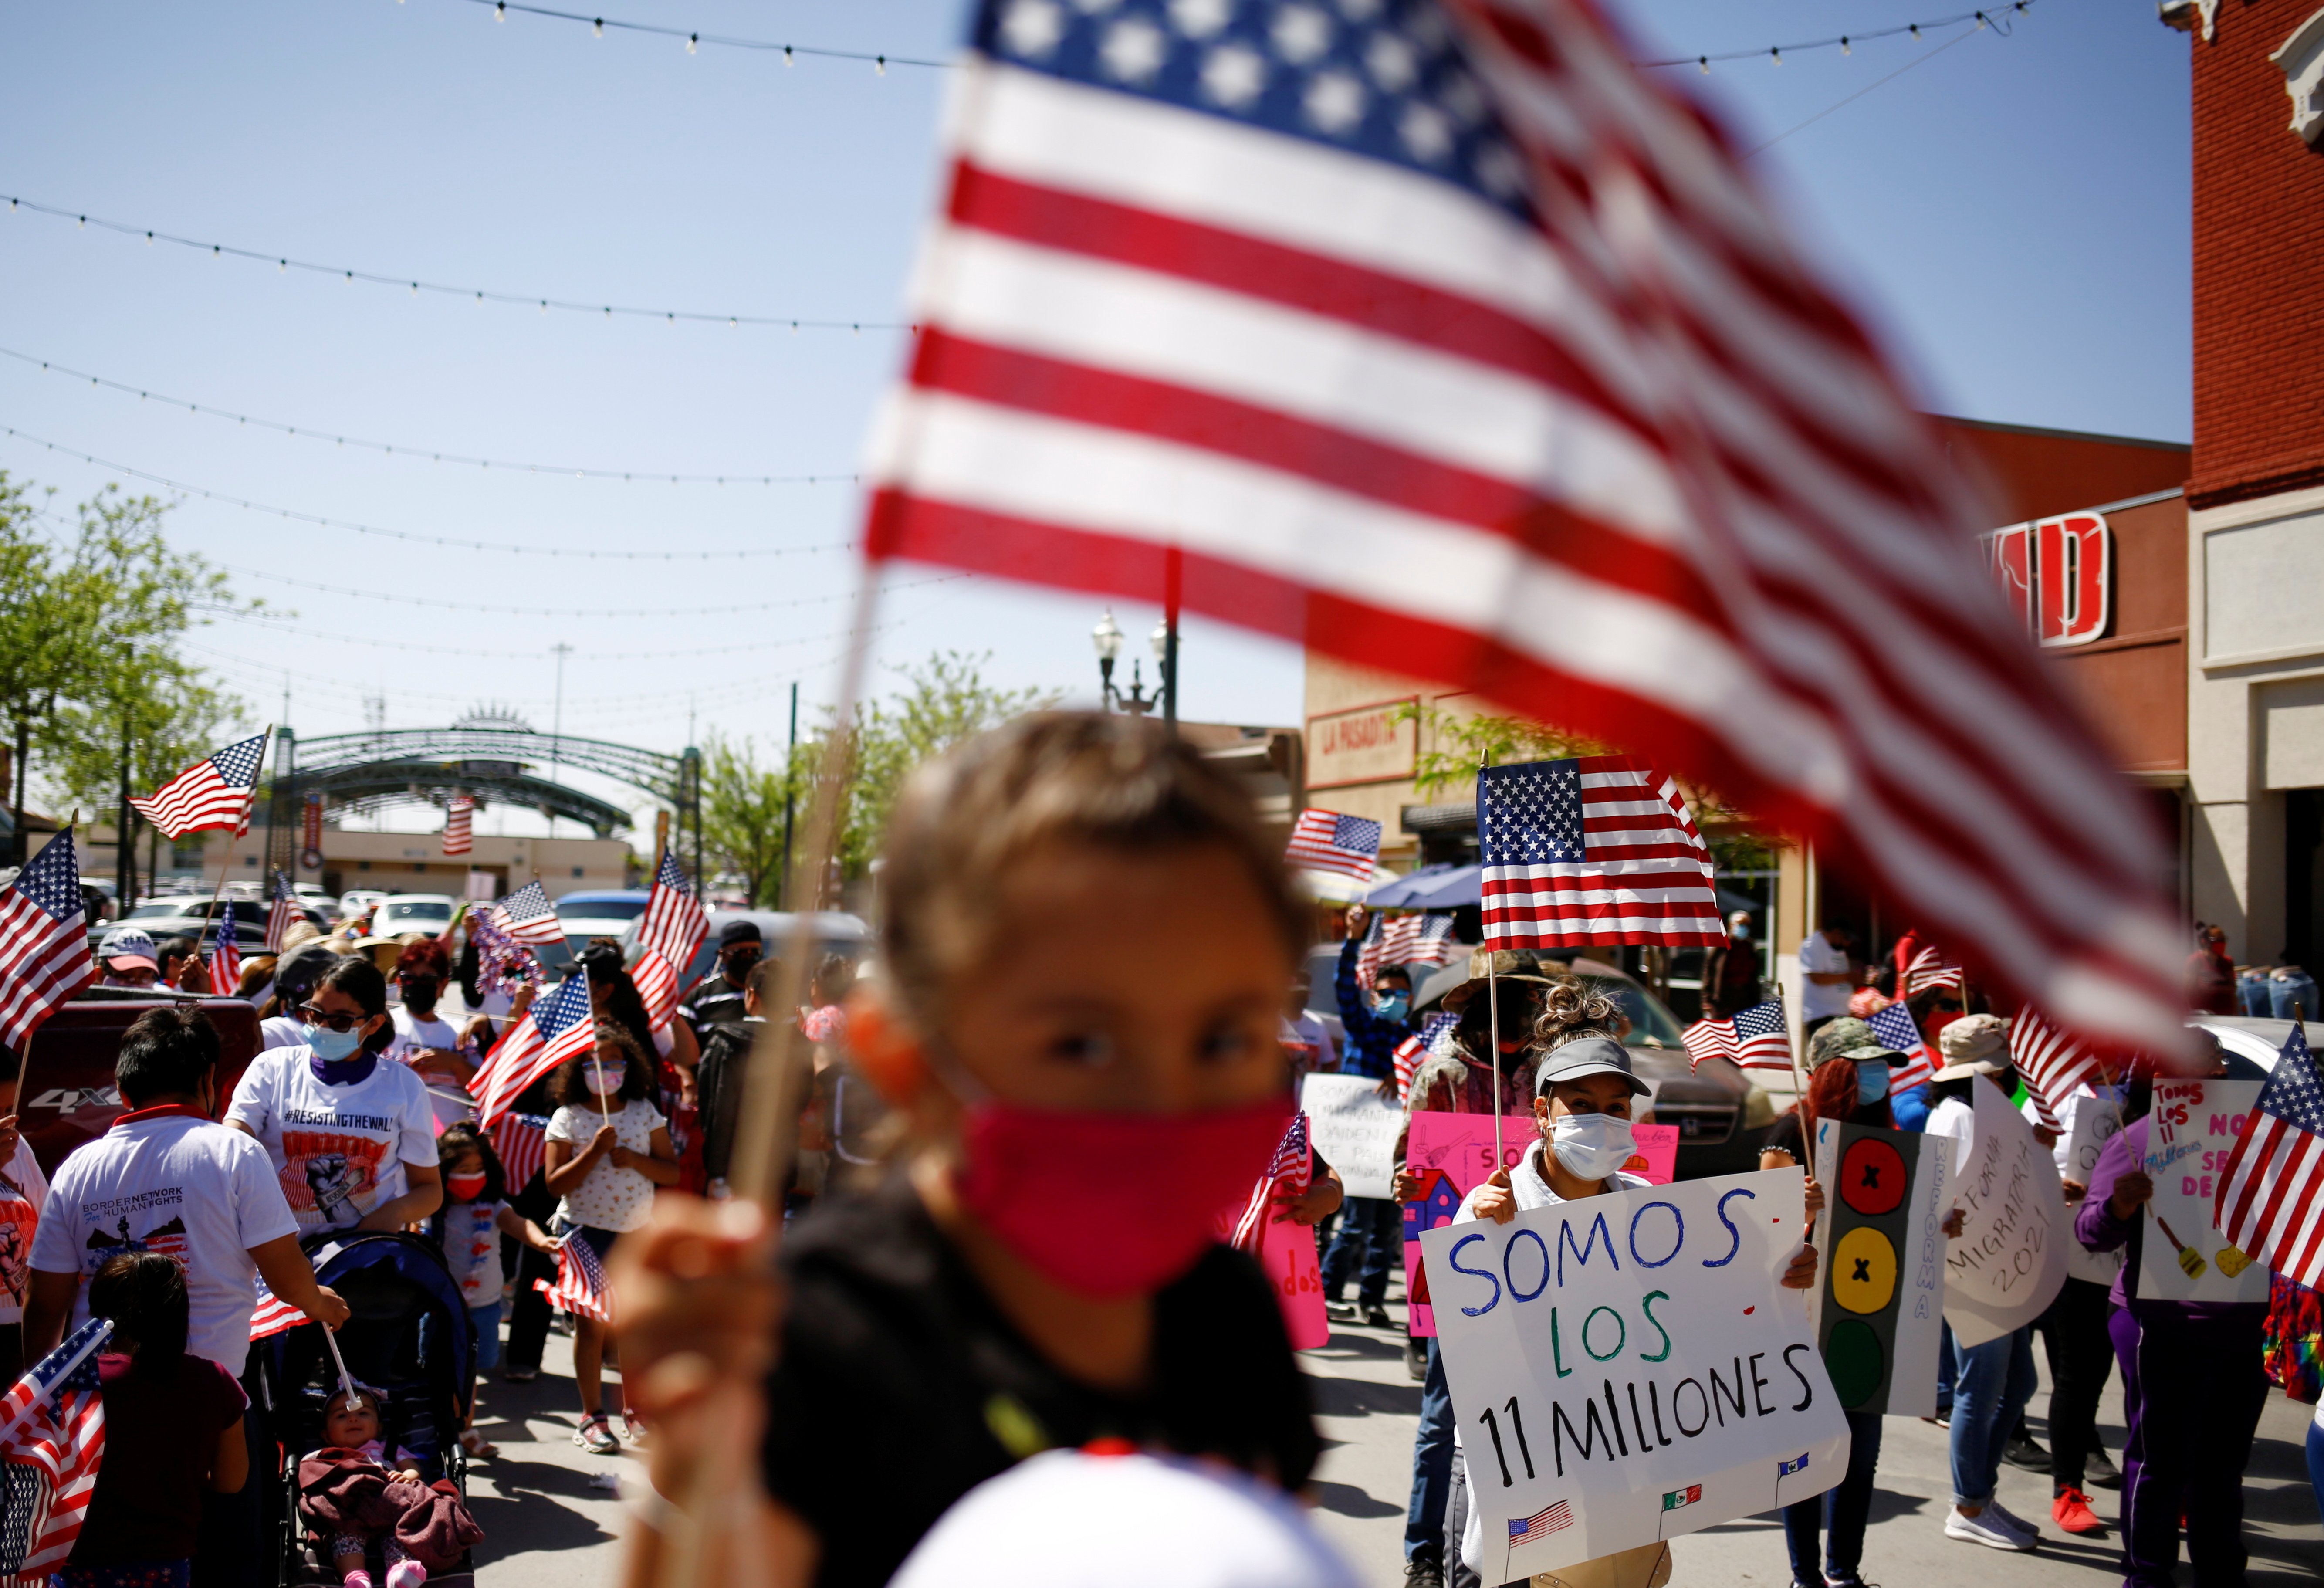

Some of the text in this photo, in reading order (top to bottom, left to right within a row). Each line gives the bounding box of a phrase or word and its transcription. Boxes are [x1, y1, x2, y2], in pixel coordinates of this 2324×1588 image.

[2209, 1113, 2248, 1137] NO
[104, 1202, 146, 1218] HUMAN
[1449, 1188, 1756, 1317] SOMOS
[1914, 1138, 1948, 1321] REFORMA
[1947, 1140, 2032, 1279] MIGRATORIA
[1992, 1205, 2050, 1293] 2021
[1551, 1290, 1671, 1379] LOS
[1479, 1343, 1813, 1487] 11 MILLONES
